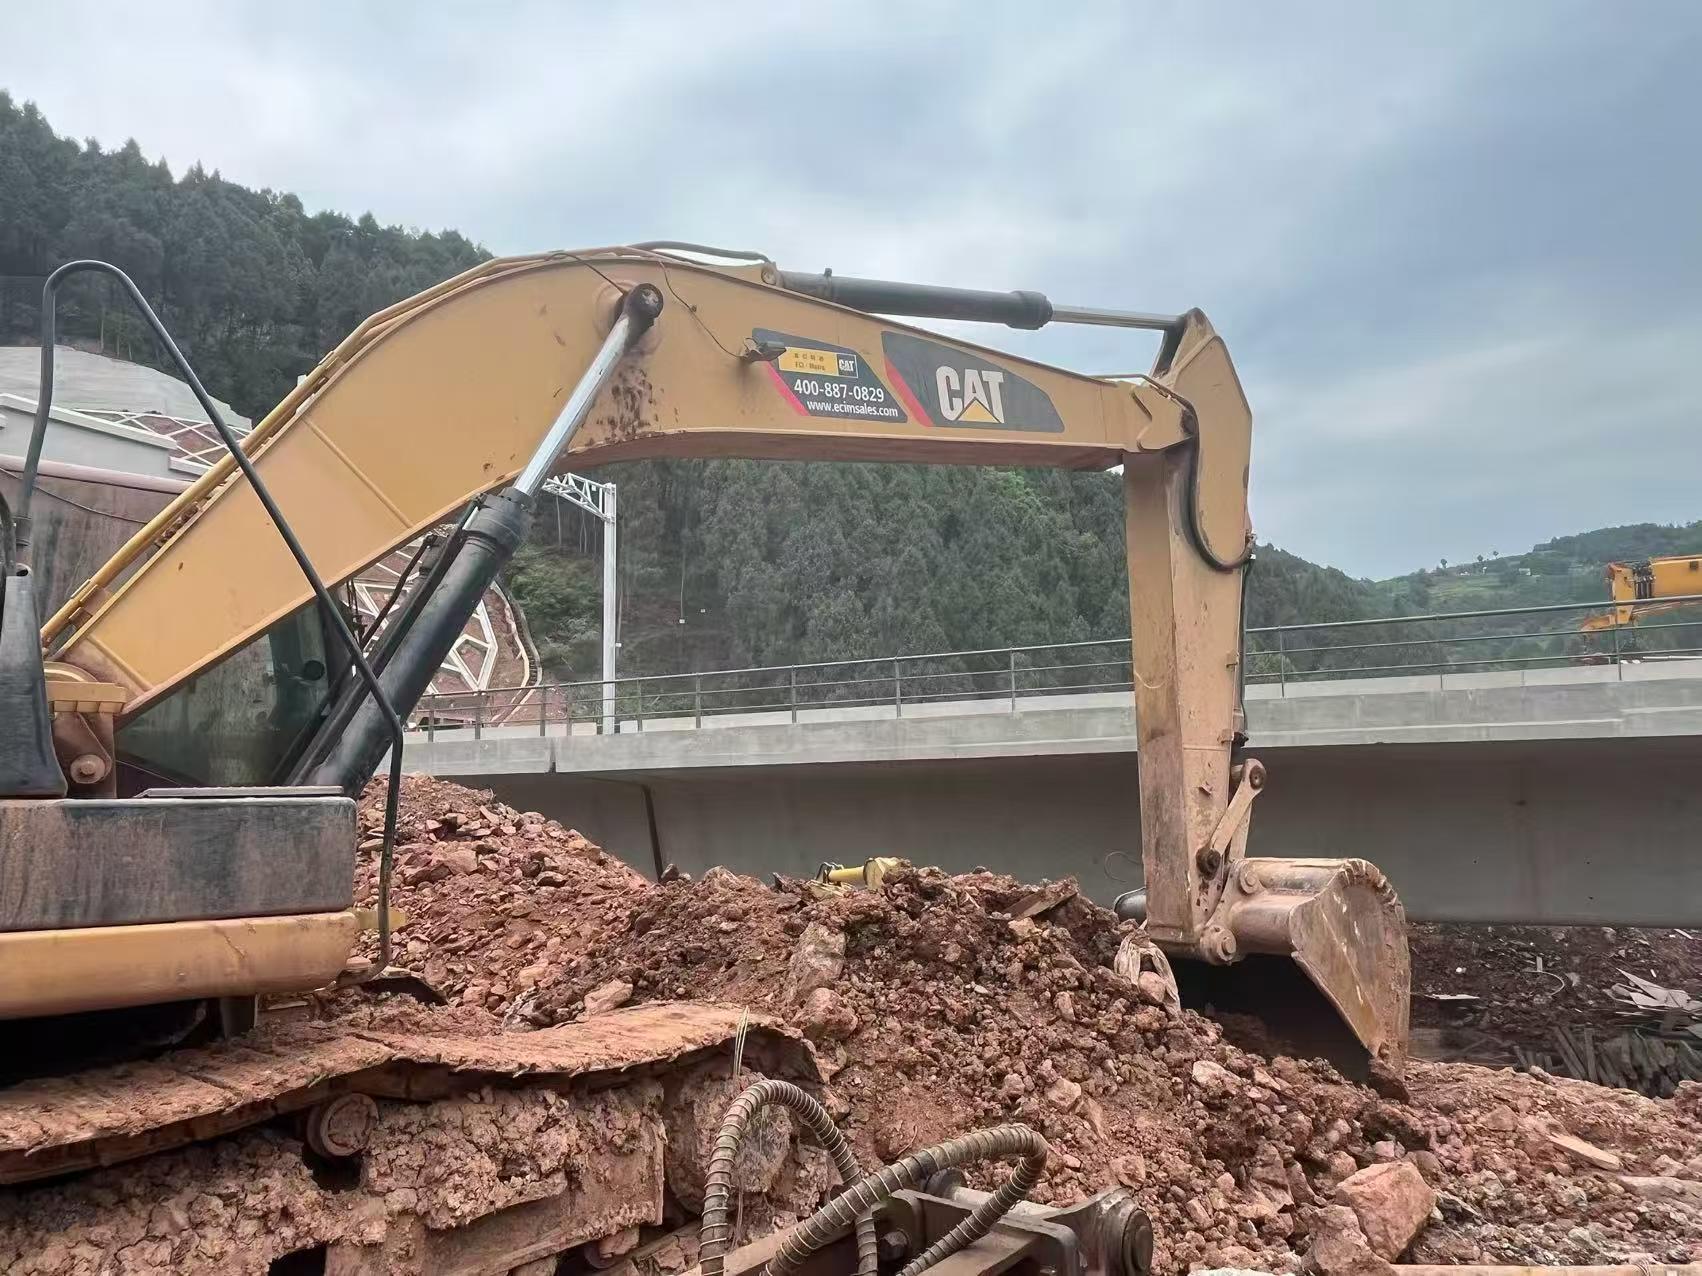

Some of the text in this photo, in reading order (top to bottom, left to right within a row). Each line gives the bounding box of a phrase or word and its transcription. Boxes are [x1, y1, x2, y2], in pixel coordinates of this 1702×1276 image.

[839, 359, 855, 372] CAT
[794, 379, 884, 402] 400-887-0829
[936, 366, 1005, 424] CAT
[807, 401, 898, 417] www.ecimsales.com
